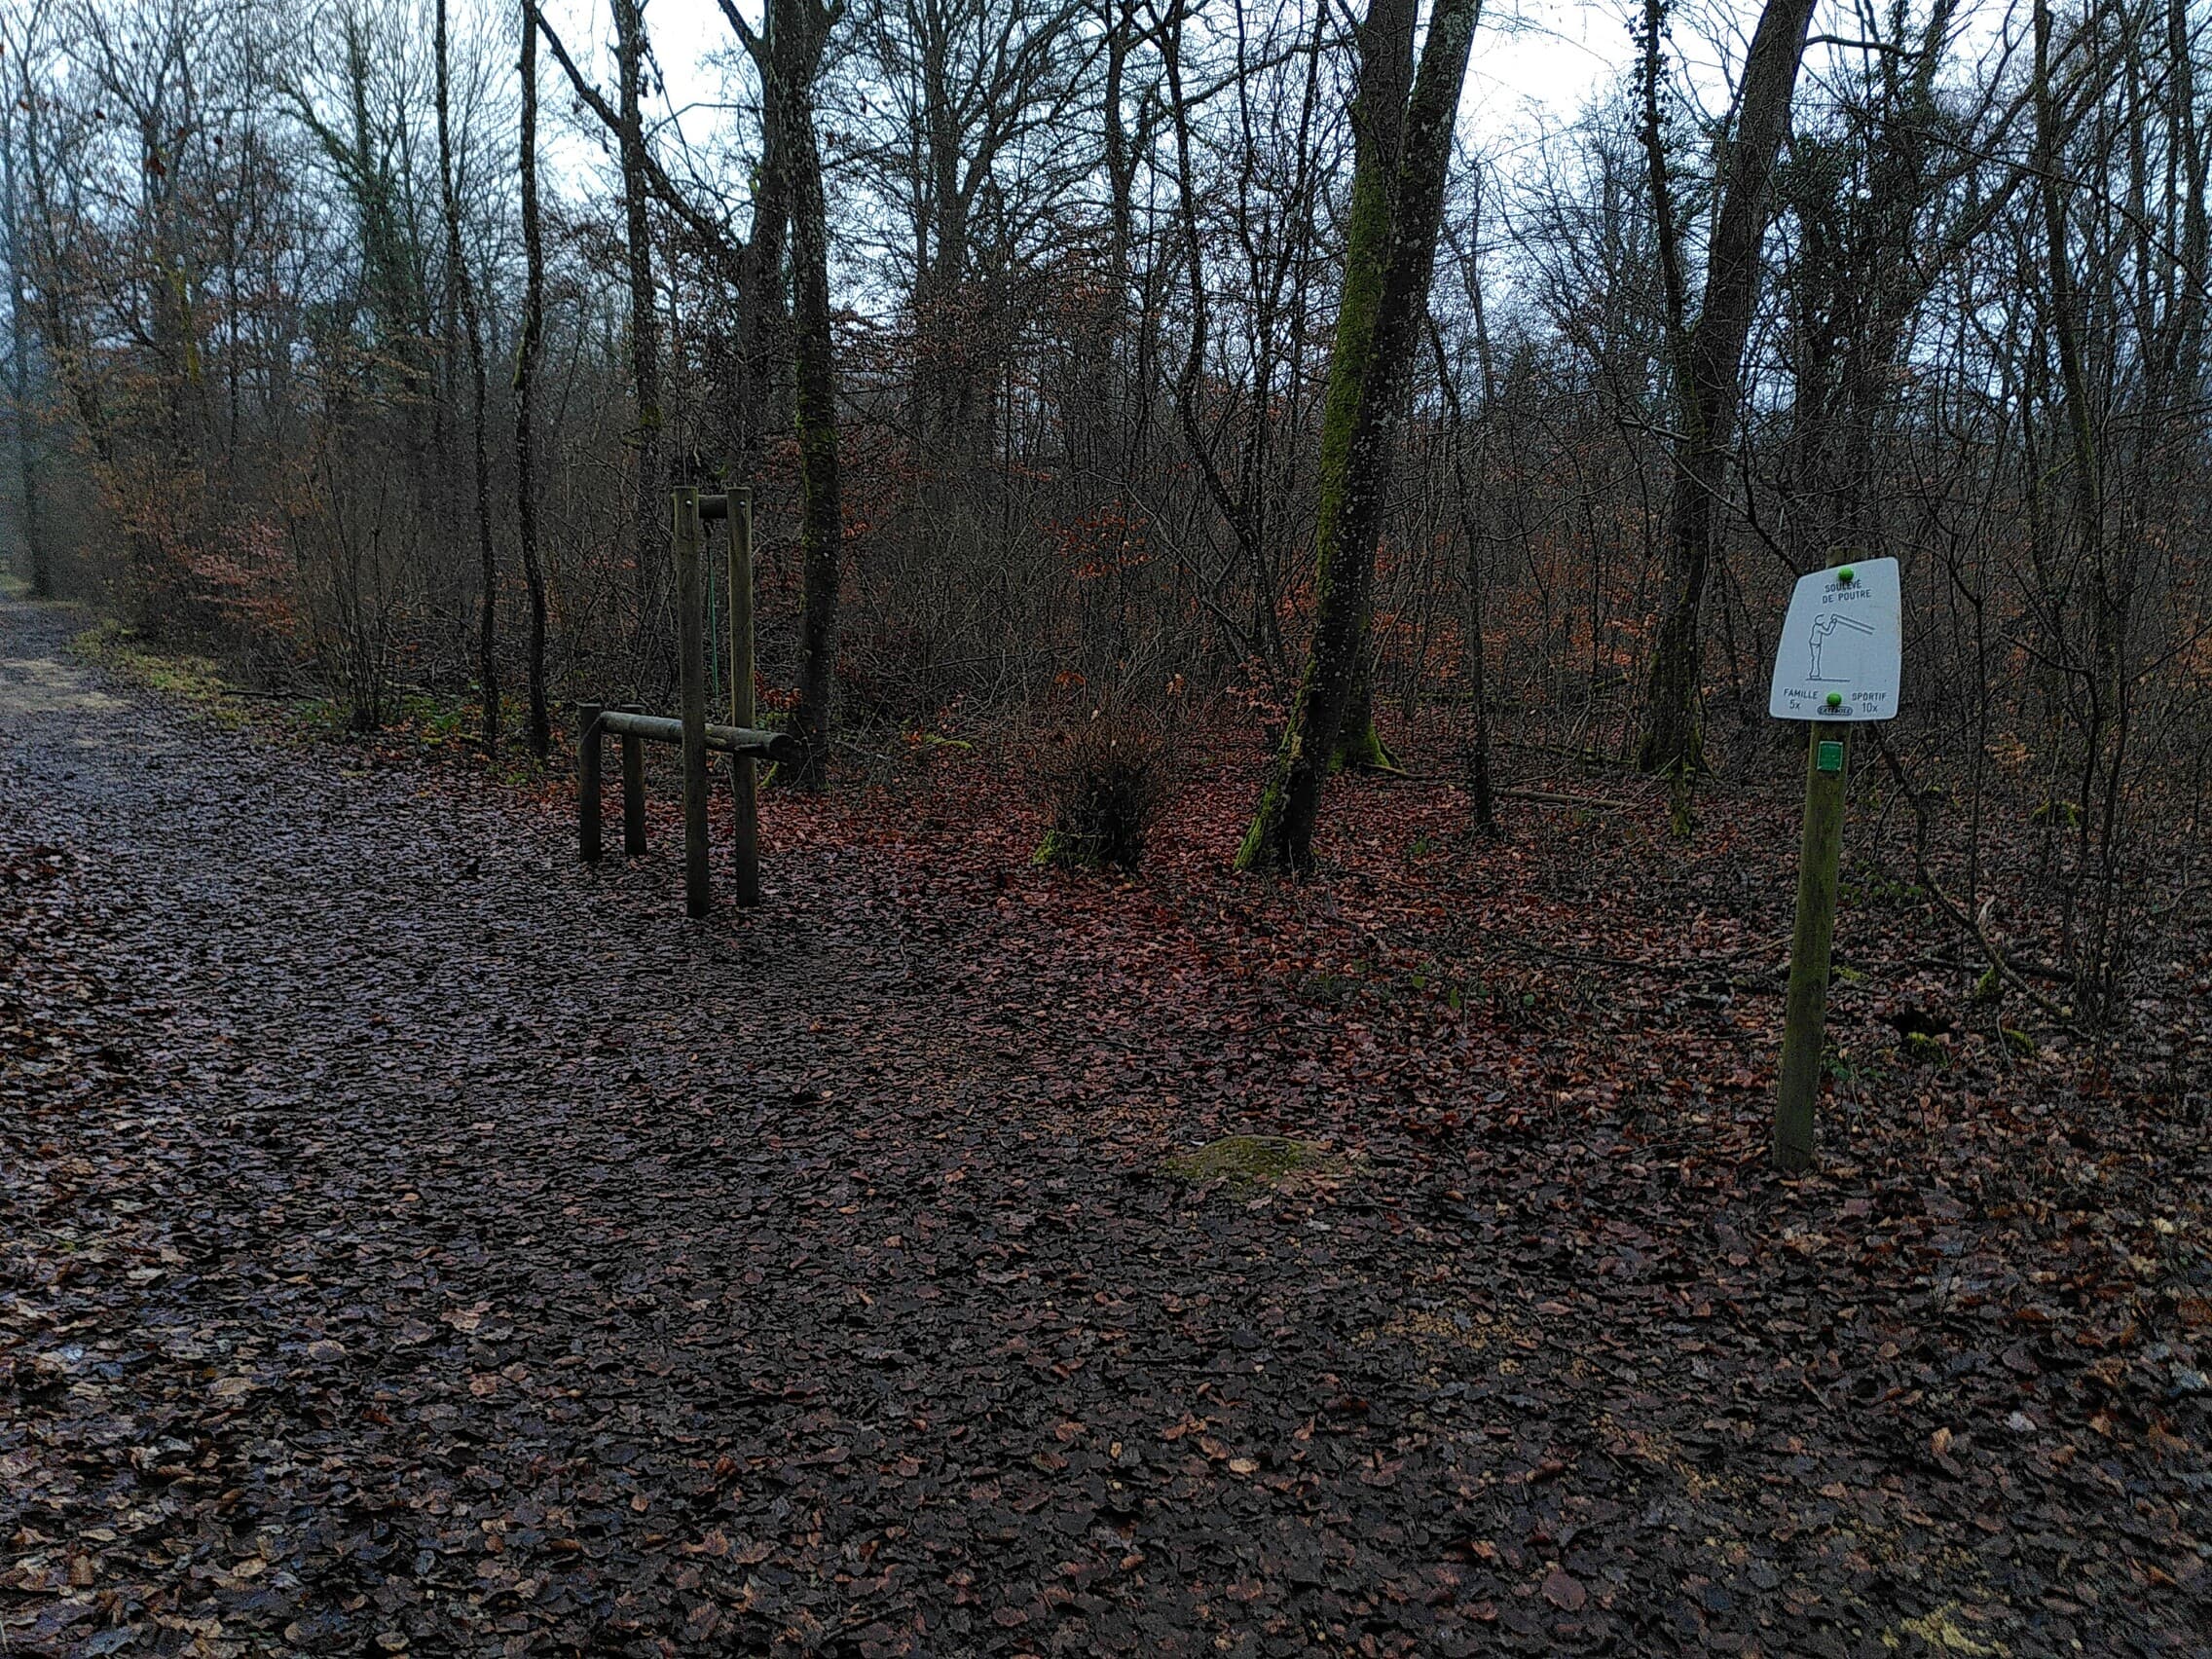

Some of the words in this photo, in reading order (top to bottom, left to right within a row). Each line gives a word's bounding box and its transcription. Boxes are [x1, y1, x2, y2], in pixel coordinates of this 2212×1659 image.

[1822, 595, 1833, 604] DE
[1838, 589, 1871, 601] POUTRE
[1784, 688, 1818, 700] FAMILLE
[1852, 692, 1887, 701] SPORTIF
[1862, 702, 1878, 713] 10x
